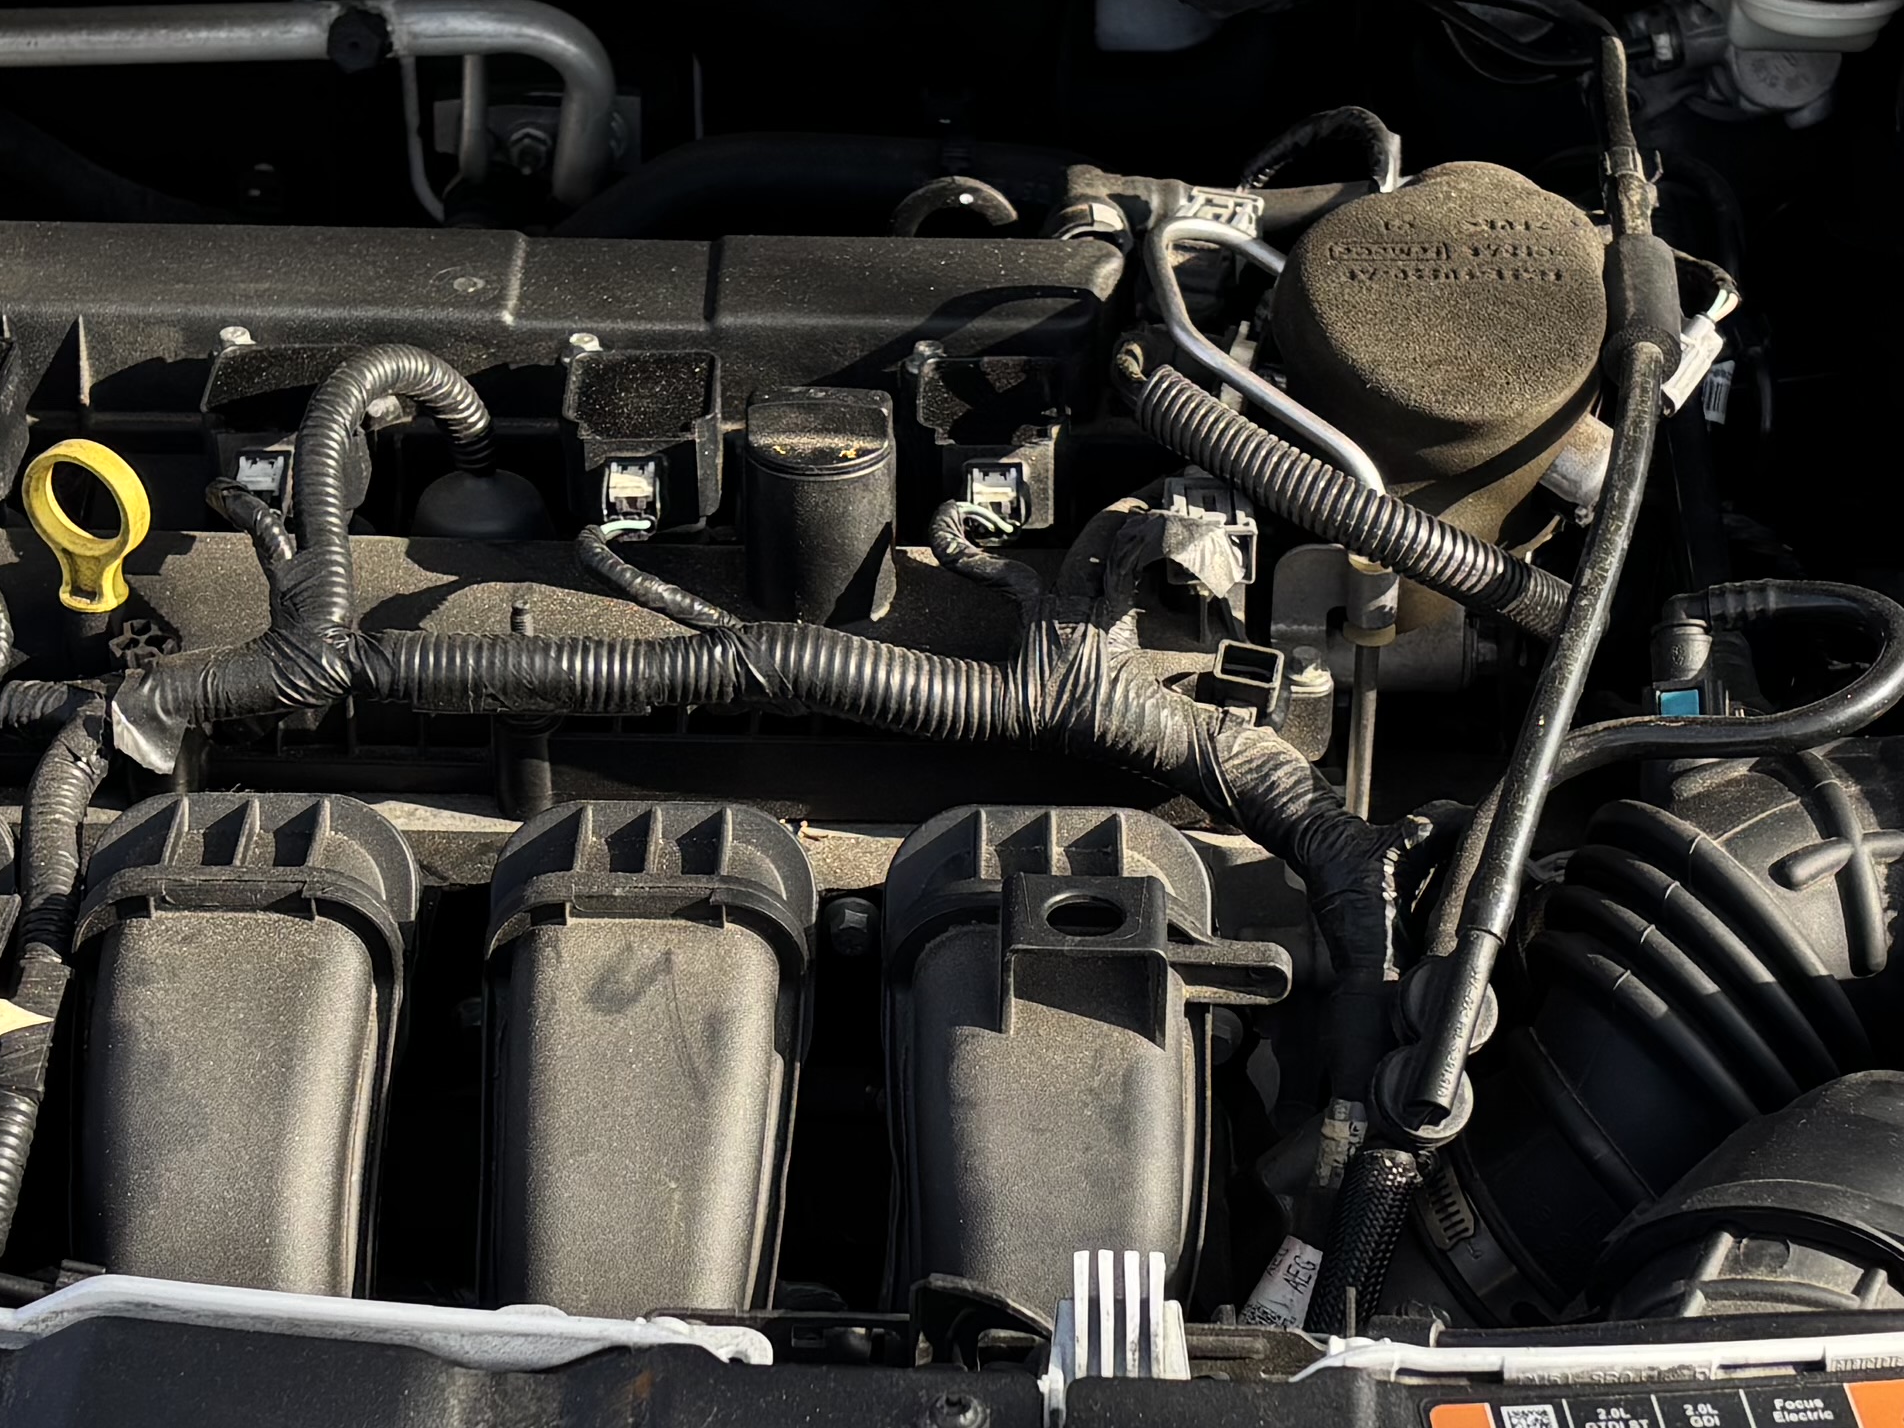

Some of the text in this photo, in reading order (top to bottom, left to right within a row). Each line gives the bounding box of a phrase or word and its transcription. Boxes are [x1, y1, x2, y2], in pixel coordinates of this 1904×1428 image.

[1683, 1403, 1719, 1416] 2.0L
[1773, 1397, 1825, 1412] Focus
[1597, 1407, 1631, 1420] 2.0L
[1772, 1409, 1835, 1424] Electric
[1689, 1415, 1721, 1428] GDI
